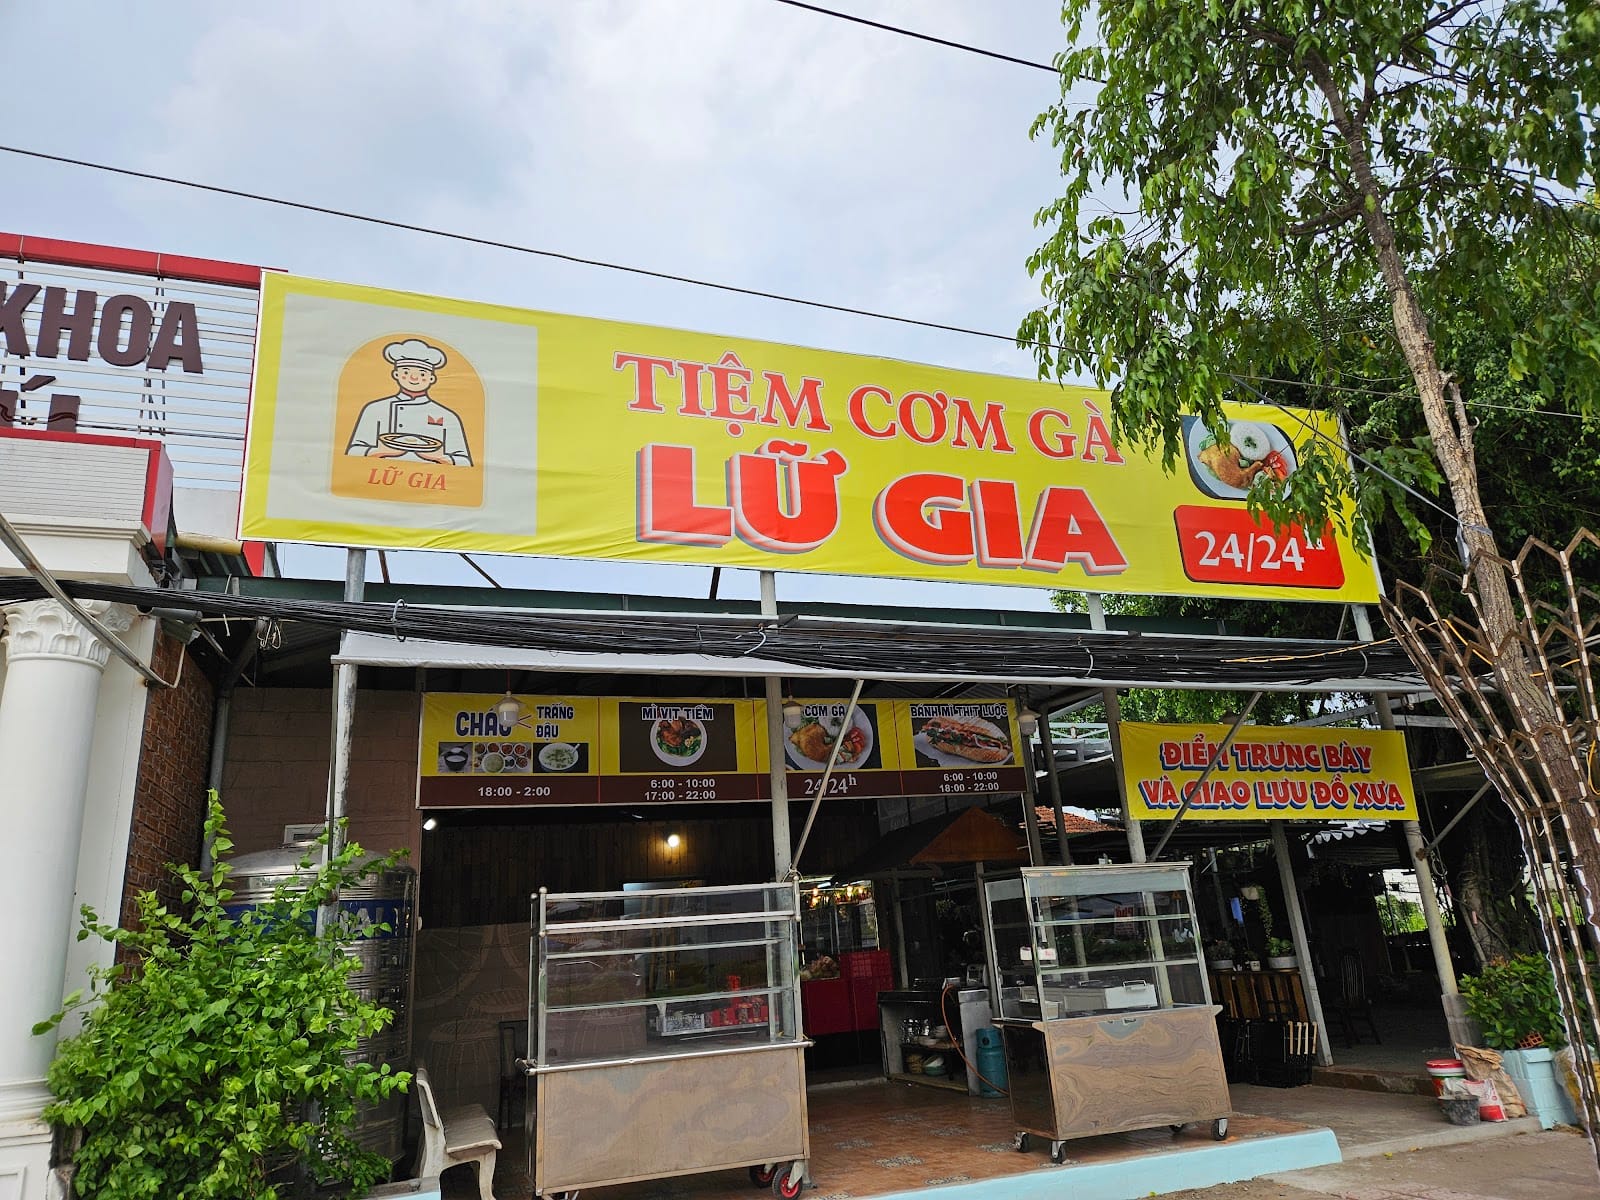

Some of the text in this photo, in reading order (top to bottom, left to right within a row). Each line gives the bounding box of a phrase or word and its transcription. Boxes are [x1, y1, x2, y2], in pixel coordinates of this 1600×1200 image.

[614, 350, 1126, 465] TIỆM CƠM GÀ
[367, 465, 447, 491] LỮ GIA
[636, 438, 1128, 576] LỮ GIA
[642, 704, 657, 720] MÌ
[660, 706, 681, 723] VỊT
[910, 703, 939, 718] BÁNH
[940, 703, 955, 718] MÌ
[535, 721, 559, 741] ĐẬU
[1230, 741, 1322, 773] TRƯNG
[1322, 740, 1373, 773] BÀY
[650, 778, 675, 789] 6:00
[686, 778, 716, 789] 10:00
[943, 773, 963, 782] 6:00
[972, 771, 998, 781] 10:00
[478, 786, 512, 797] 18:00
[524, 786, 551, 796] 2:00
[644, 790, 675, 801] 17:00
[686, 790, 716, 800] 22:00
[938, 784, 964, 793] 18:00
[974, 782, 1000, 792] 22:00
[1139, 771, 1406, 811] VÀ GIAO LƯU ĐỒ XƯA
